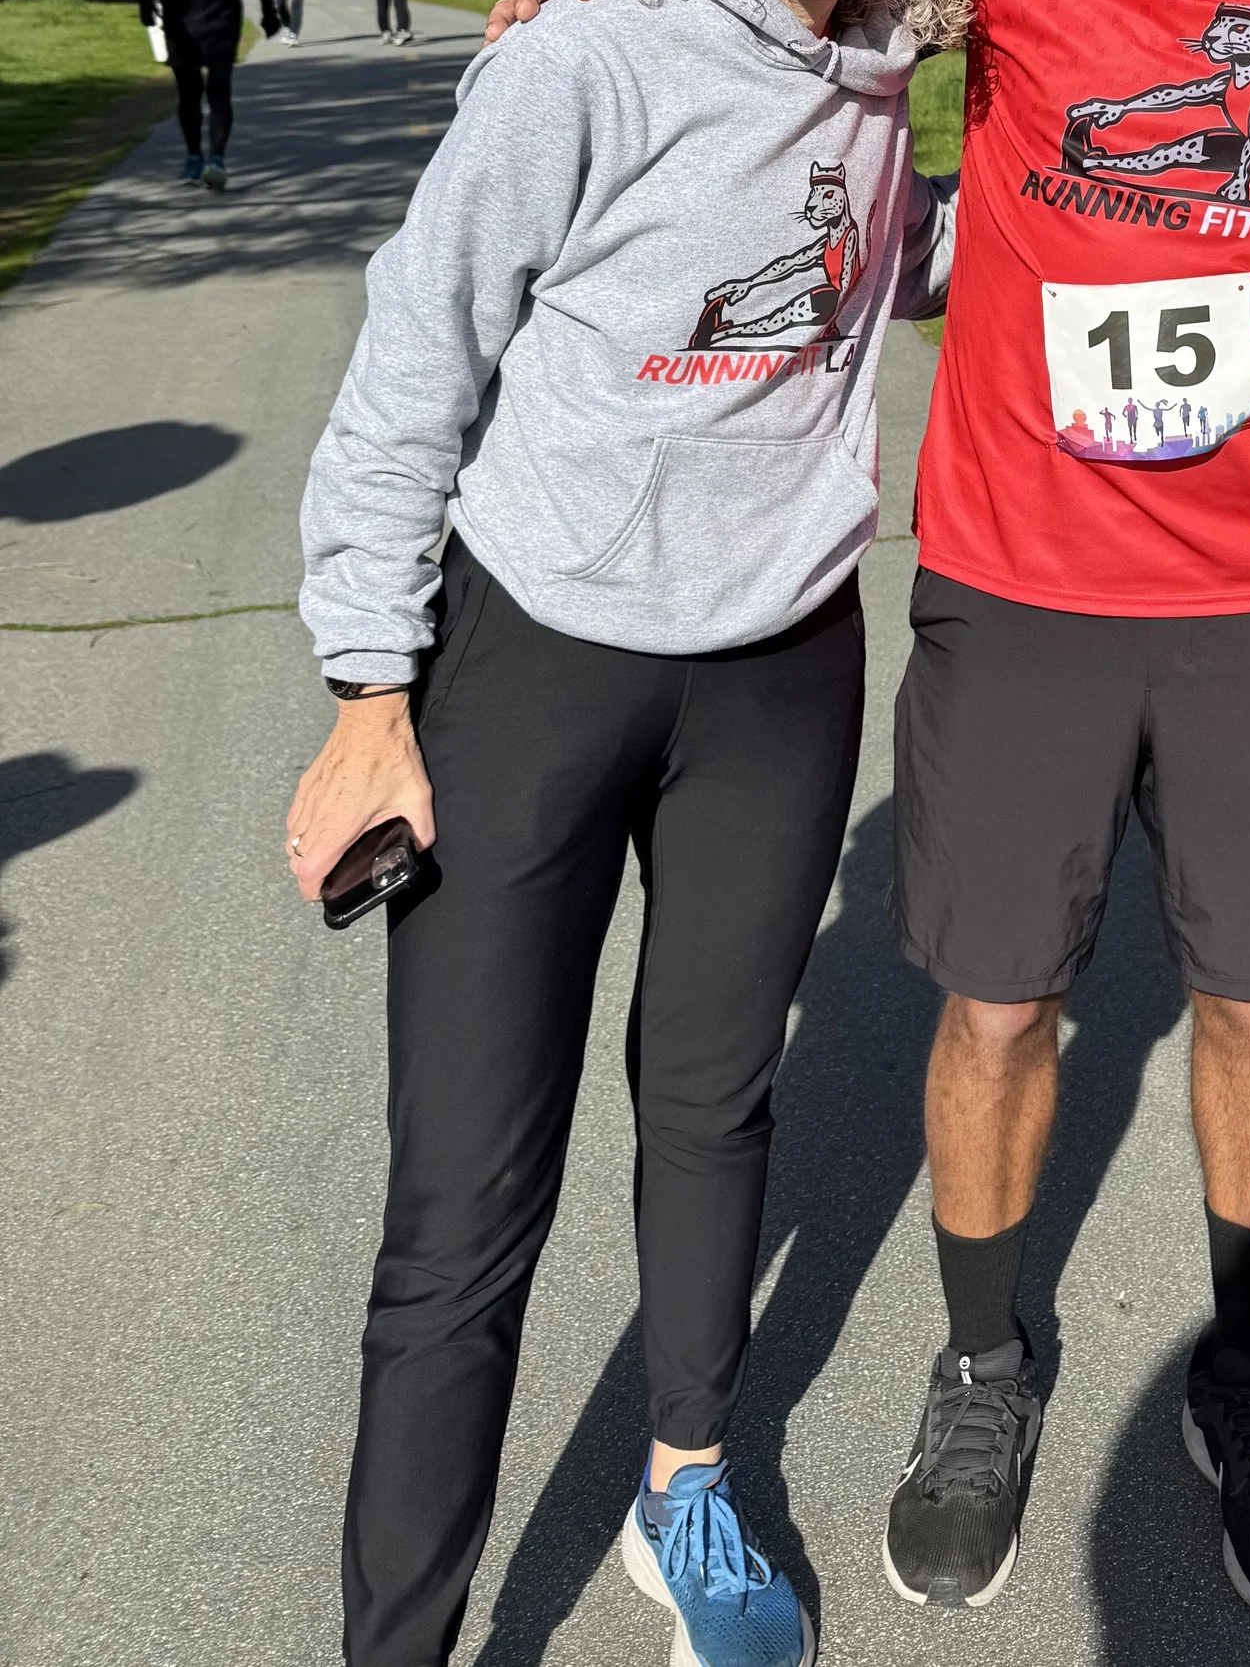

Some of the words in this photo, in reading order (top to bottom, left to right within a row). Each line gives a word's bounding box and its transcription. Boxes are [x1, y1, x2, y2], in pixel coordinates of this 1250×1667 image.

[1020, 170, 1192, 230] RUNNING
[636, 354, 784, 385] RUNNIN
[1087, 304, 1216, 390] 15
